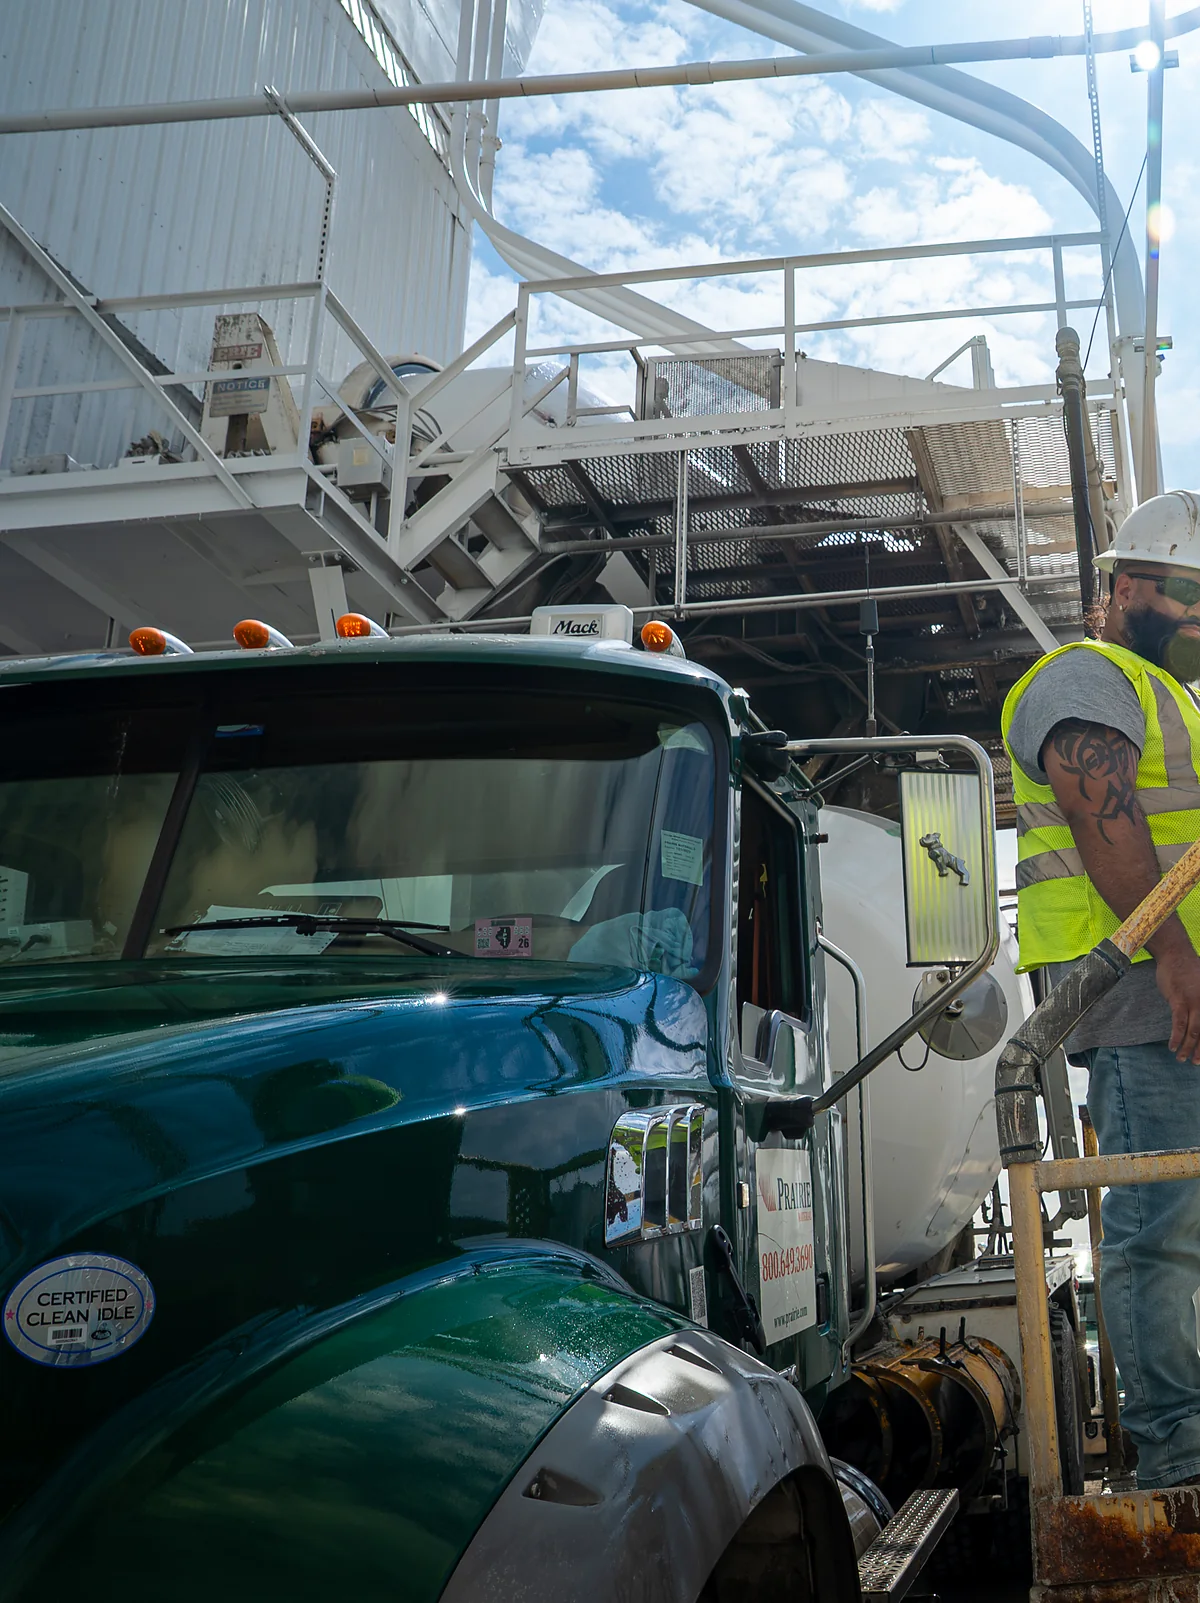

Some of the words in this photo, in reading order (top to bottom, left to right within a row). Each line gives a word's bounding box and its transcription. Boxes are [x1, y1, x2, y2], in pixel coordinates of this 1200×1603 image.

[218, 380, 265, 391] NOTICE
[552, 619, 600, 637] Mack
[518, 938, 530, 948] 26
[777, 1178, 811, 1210] PRAIRIE
[762, 1244, 812, 1281] 800.649.3690
[37, 1288, 128, 1306] CERTIFIED
[26, 1309, 89, 1327] CLEAN
[98, 1306, 135, 1321] IDLE
[774, 1306, 807, 1328] www.prairie.com
